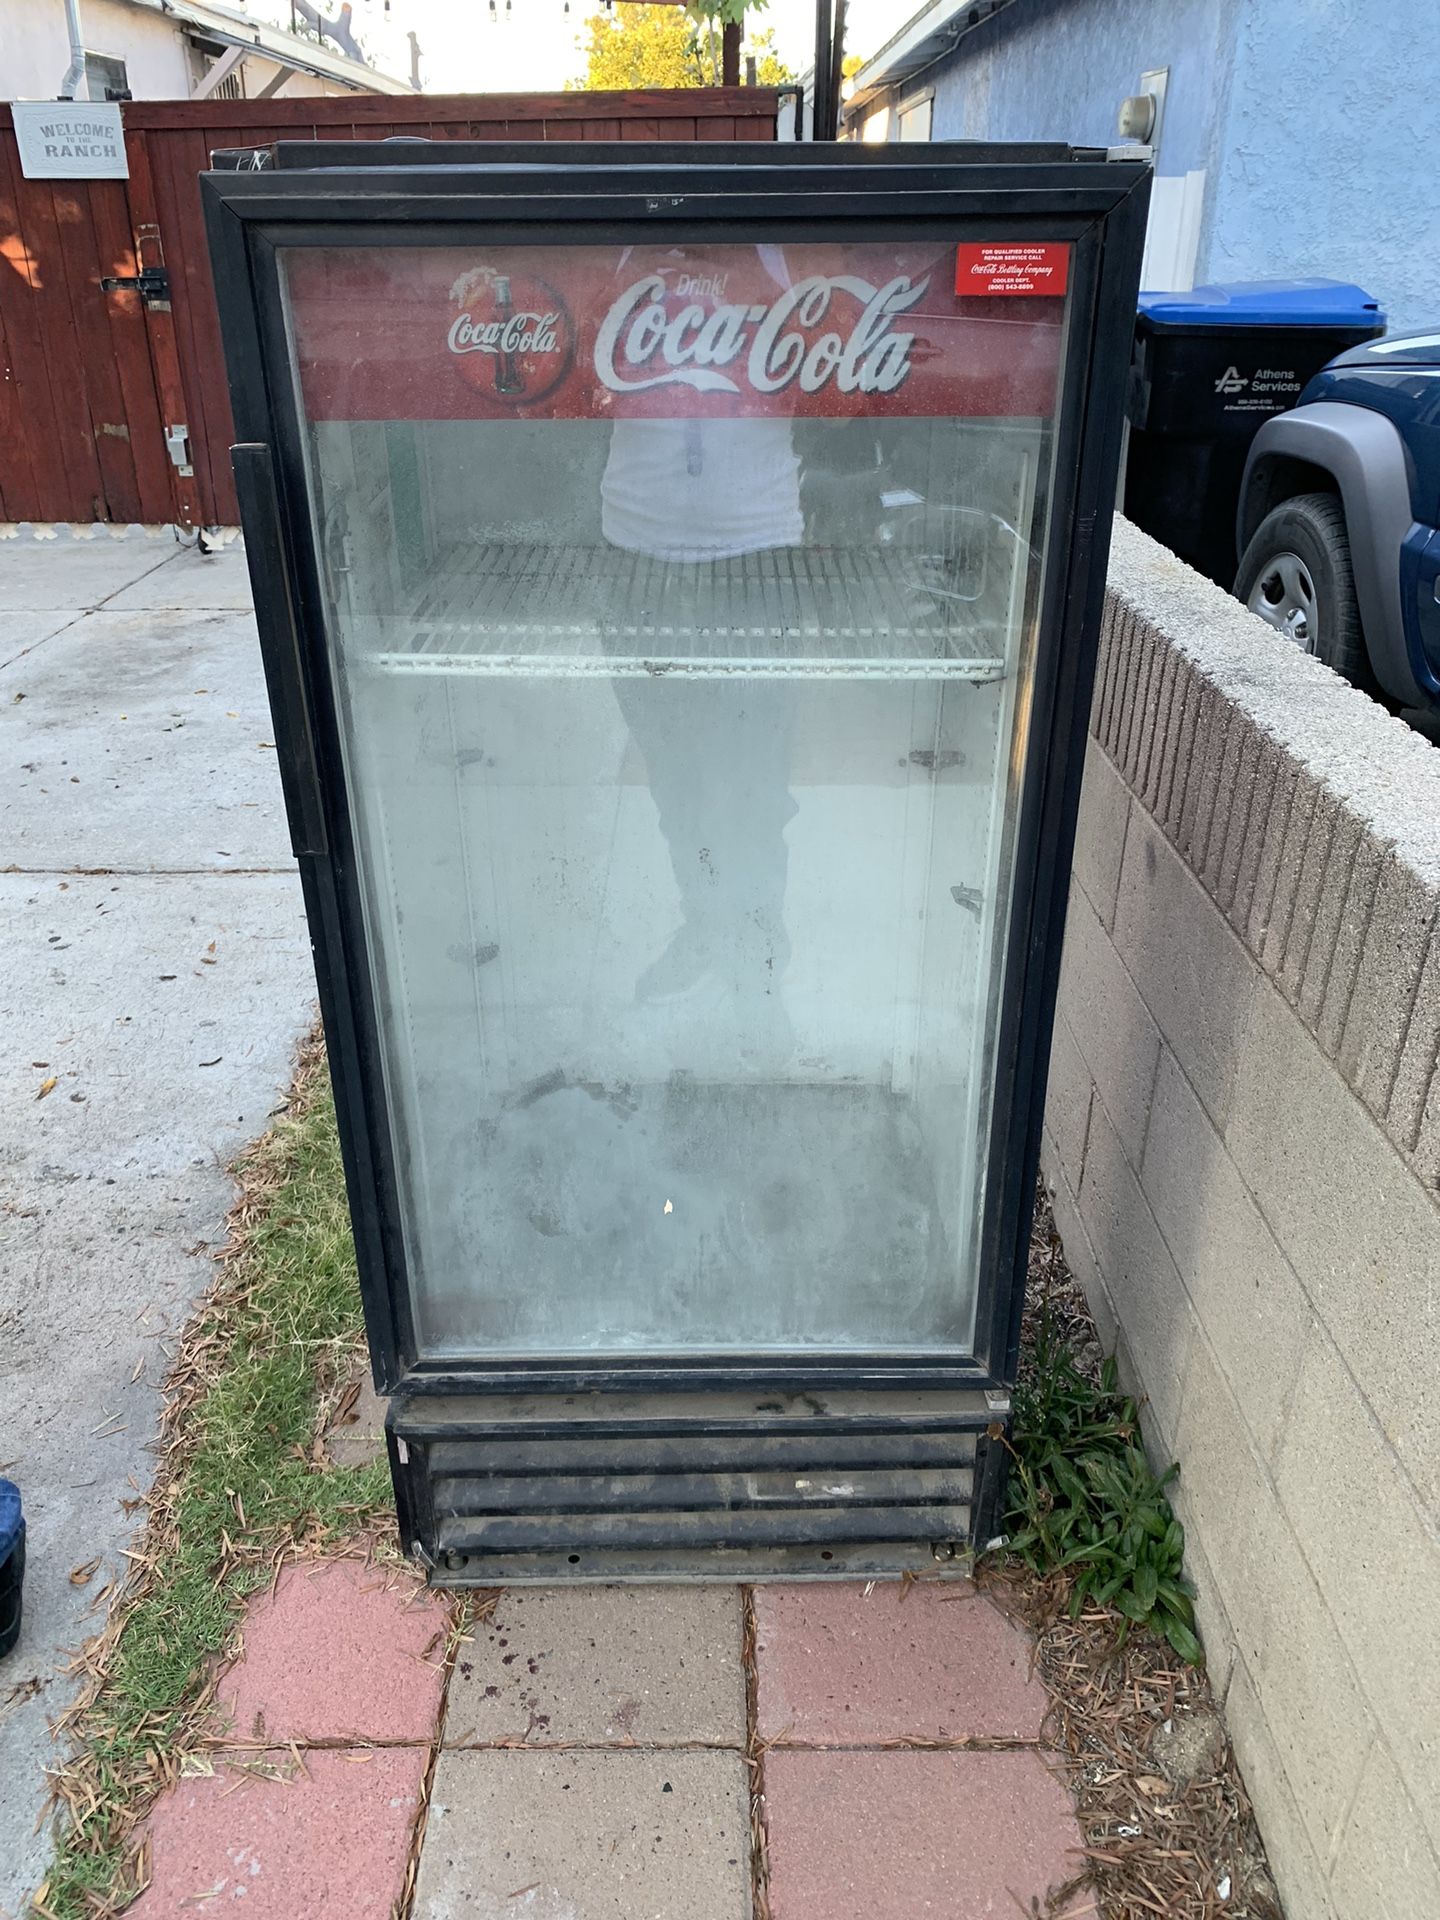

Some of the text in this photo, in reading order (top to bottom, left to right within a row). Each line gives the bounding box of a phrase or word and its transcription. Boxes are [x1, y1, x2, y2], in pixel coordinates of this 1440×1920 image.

[40, 123, 115, 139] WELCOME
[44, 145, 117, 158] RANCH
[1024, 263, 1053, 277] Company
[676, 273, 726, 298] Drink!
[594, 274, 931, 394] Coca-Cola
[1254, 369, 1295, 379] Athens
[1251, 380, 1301, 392] Services
